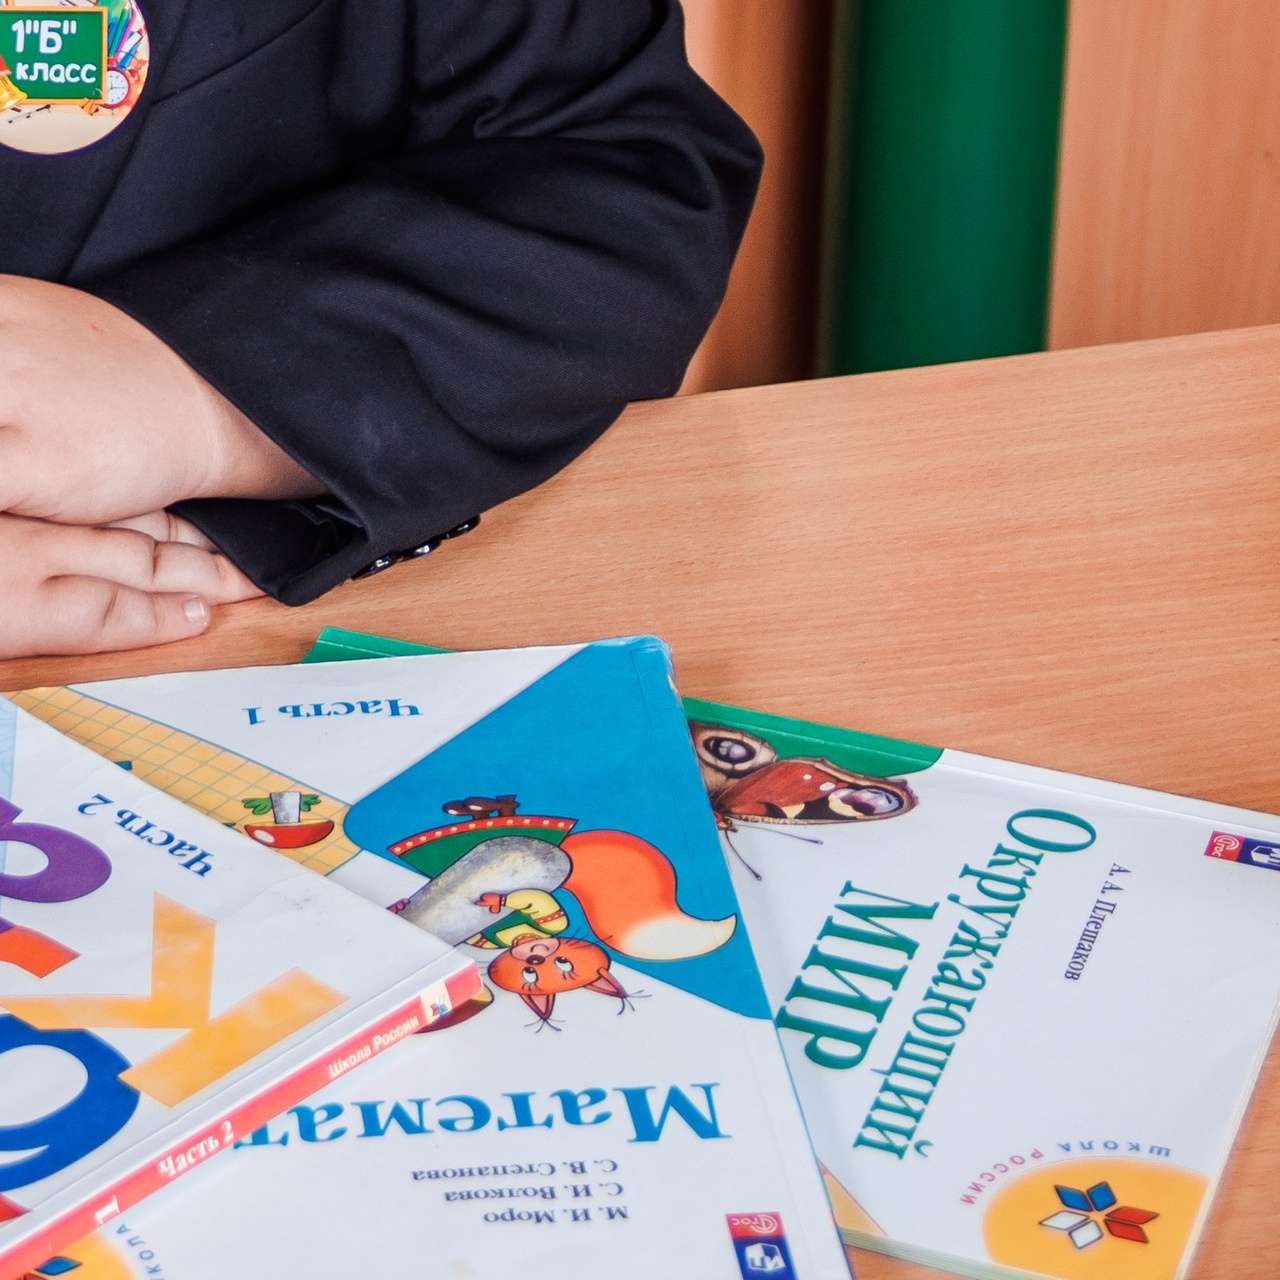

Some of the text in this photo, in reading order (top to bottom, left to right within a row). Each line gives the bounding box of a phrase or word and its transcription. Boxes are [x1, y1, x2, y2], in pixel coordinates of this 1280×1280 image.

[241, 697, 424, 726] Часть 1
[77, 793, 214, 878] Часть 2
[1064, 899, 1117, 981] Плешаков
[776, 880, 939, 1069] МИР
[853, 808, 1097, 1159] Окружающий
[158, 1133, 220, 1178] Часть
[220, 1120, 235, 1142] 2
[328, 1046, 372, 1079] Школа
[372, 1014, 419, 1051] России
[233, 1082, 732, 1150] Математ
[411, 1159, 618, 1181] С. В. Степанова
[444, 1182, 624, 1202] С. И. Волкова
[960, 1140, 1171, 1205] ШКОЛА РОССИИ
[483, 1205, 629, 1224] М. И. Моро
[116, 1224, 166, 1280] КОЛА
